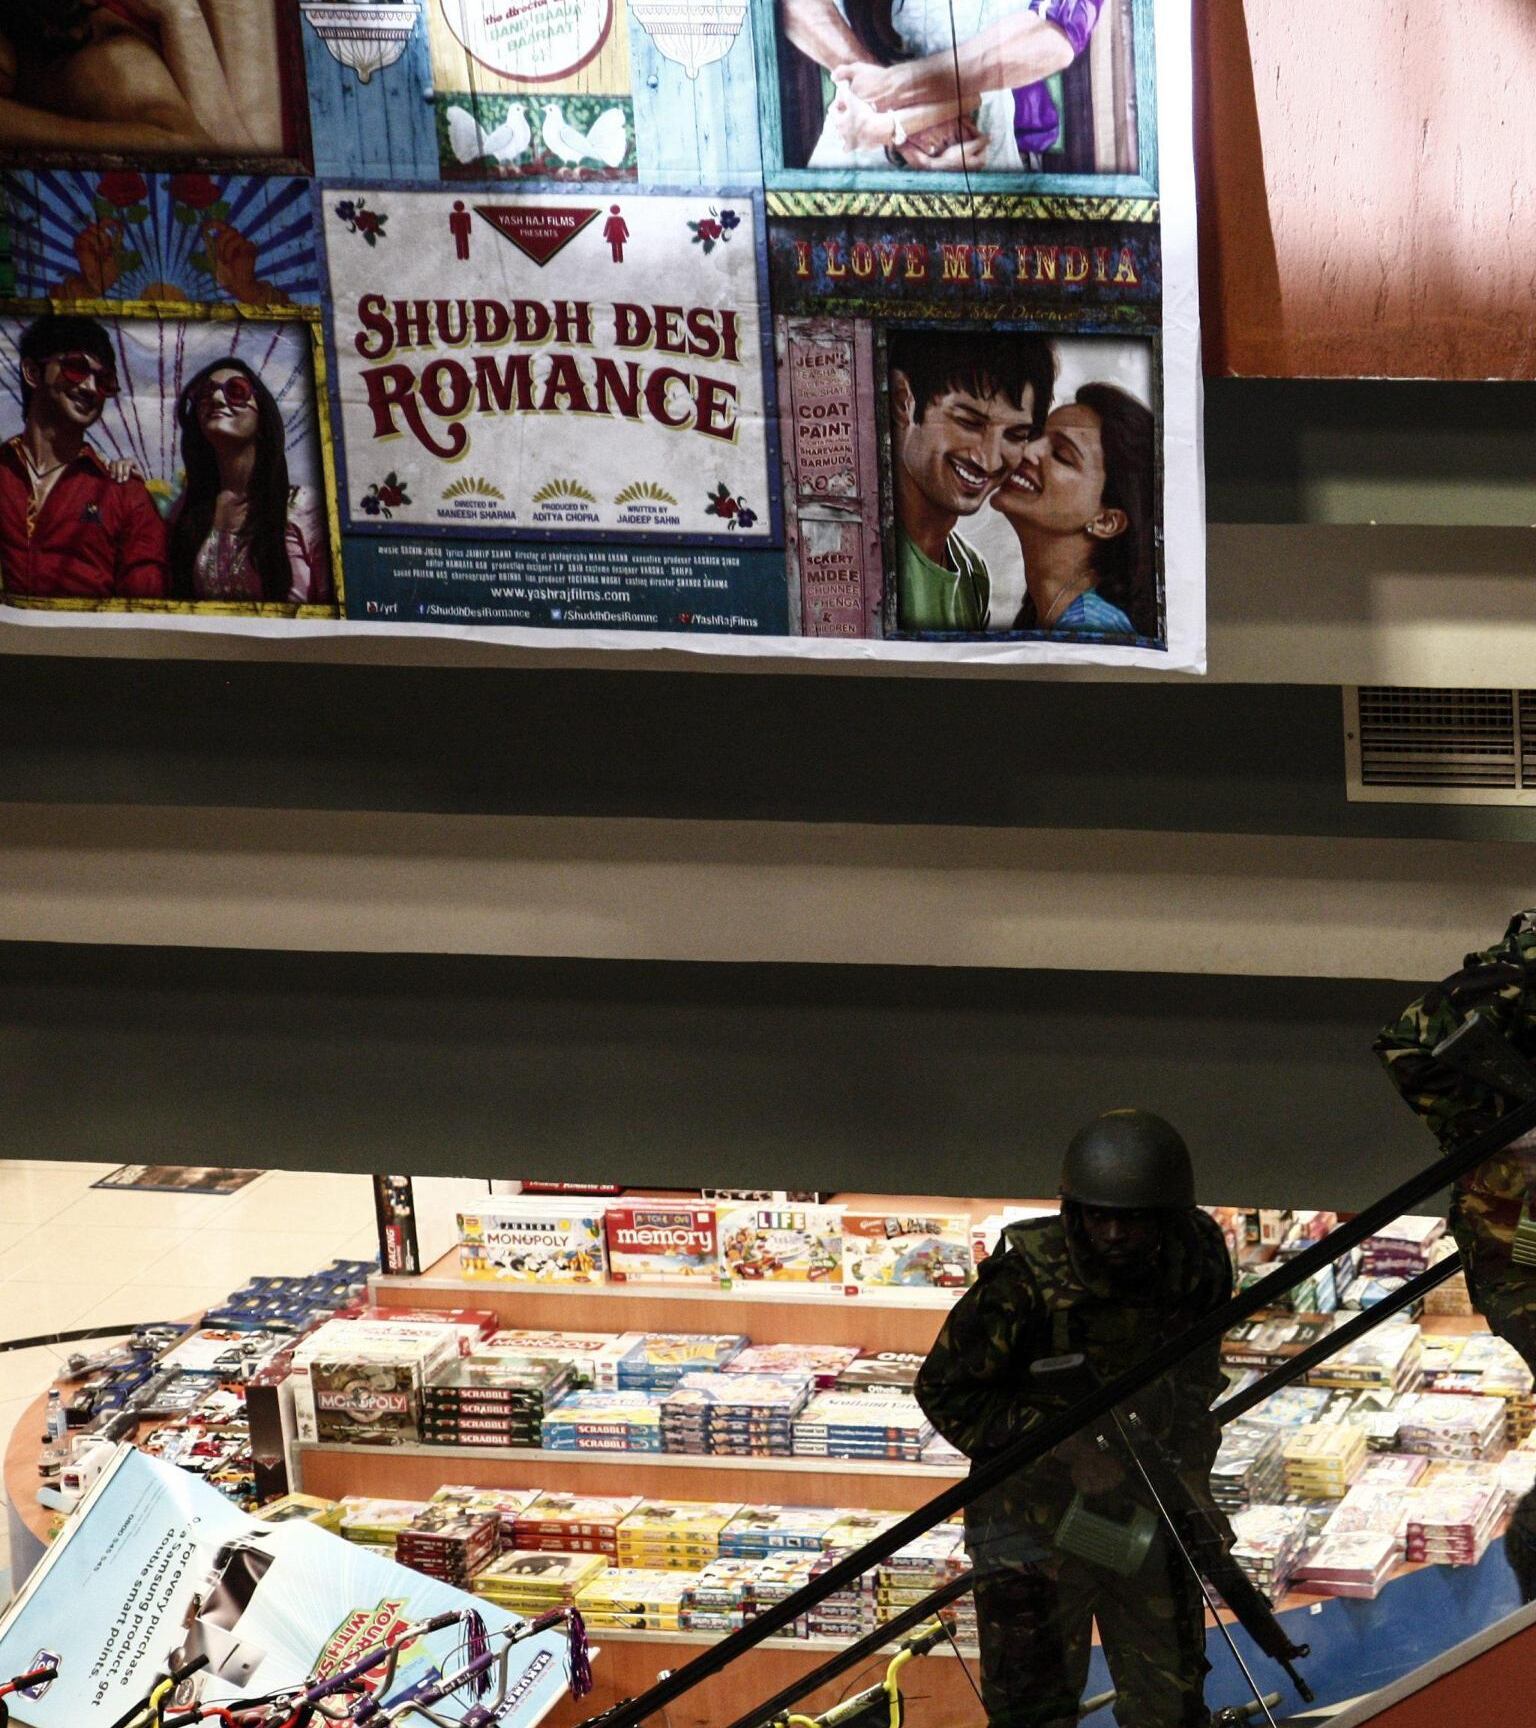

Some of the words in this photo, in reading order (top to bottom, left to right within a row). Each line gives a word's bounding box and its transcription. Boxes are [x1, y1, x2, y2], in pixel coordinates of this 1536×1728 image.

[484, 14, 503, 25] the
[506, 0, 547, 19] director
[499, 215, 523, 225] YASH
[525, 216, 545, 226] RAJ
[547, 216, 575, 227] FILMS
[520, 229, 558, 237] PRESENTS
[795, 240, 812, 278] I
[824, 241, 929, 282] LOVE
[941, 243, 1002, 282] MY
[1015, 244, 1142, 287] INDIA
[355, 293, 594, 360] SHUDDH
[612, 302, 742, 364] DESI
[359, 354, 740, 463] ROMANCE
[799, 402, 849, 419] COAT
[800, 422, 851, 438] PAINT
[801, 456, 853, 467] BARMUDA
[454, 500, 486, 508] DIRECTED
[541, 503, 576, 511] PRODUCED
[627, 505, 656, 513] WRITTEN
[437, 509, 478, 519] MANEESH
[480, 511, 516, 520] SHARMA
[532, 512, 564, 522] ADITYA
[566, 513, 599, 522] CHOPRA
[616, 514, 652, 524] JAIDEEP
[654, 515, 680, 525] SAHNI
[807, 570, 859, 583] MIDEE
[490, 587, 630, 603] www.yashrajfilms.com
[758, 1211, 806, 1230] LIFE
[487, 1232, 569, 1248] MONOPOLY
[616, 1228, 713, 1253] memory
[386, 1228, 397, 1269] RACING
[493, 1338, 599, 1349] MONOPOLY
[877, 1352, 927, 1363] Oth
[320, 1394, 405, 1411] MONOPOLY
[460, 1389, 510, 1400] SCRABBLE
[462, 1405, 511, 1415] SCRABBLE
[460, 1419, 509, 1430] SCRABBLE
[578, 1425, 627, 1435] SCRABBLE
[460, 1434, 510, 1444] SCRABBLE
[578, 1439, 627, 1449] SCRABBLE
[117, 1514, 134, 1536] 0800
[105, 1538, 119, 1554] 545
[140, 1528, 175, 1576] double
[93, 1555, 107, 1571] 545
[180, 1542, 196, 1568] For
[138, 1543, 182, 1611] Samsung
[156, 1570, 182, 1614] every
[117, 1580, 142, 1625] smart
[356, 1602, 401, 1649] YOUR
[327, 1612, 371, 1660] WITH
[88, 1627, 119, 1679] points.
[106, 1614, 143, 1677] product,
[120, 1615, 160, 1686] purchase
[91, 1680, 109, 1706] get
[495, 1652, 551, 1719] NAKUMATT
